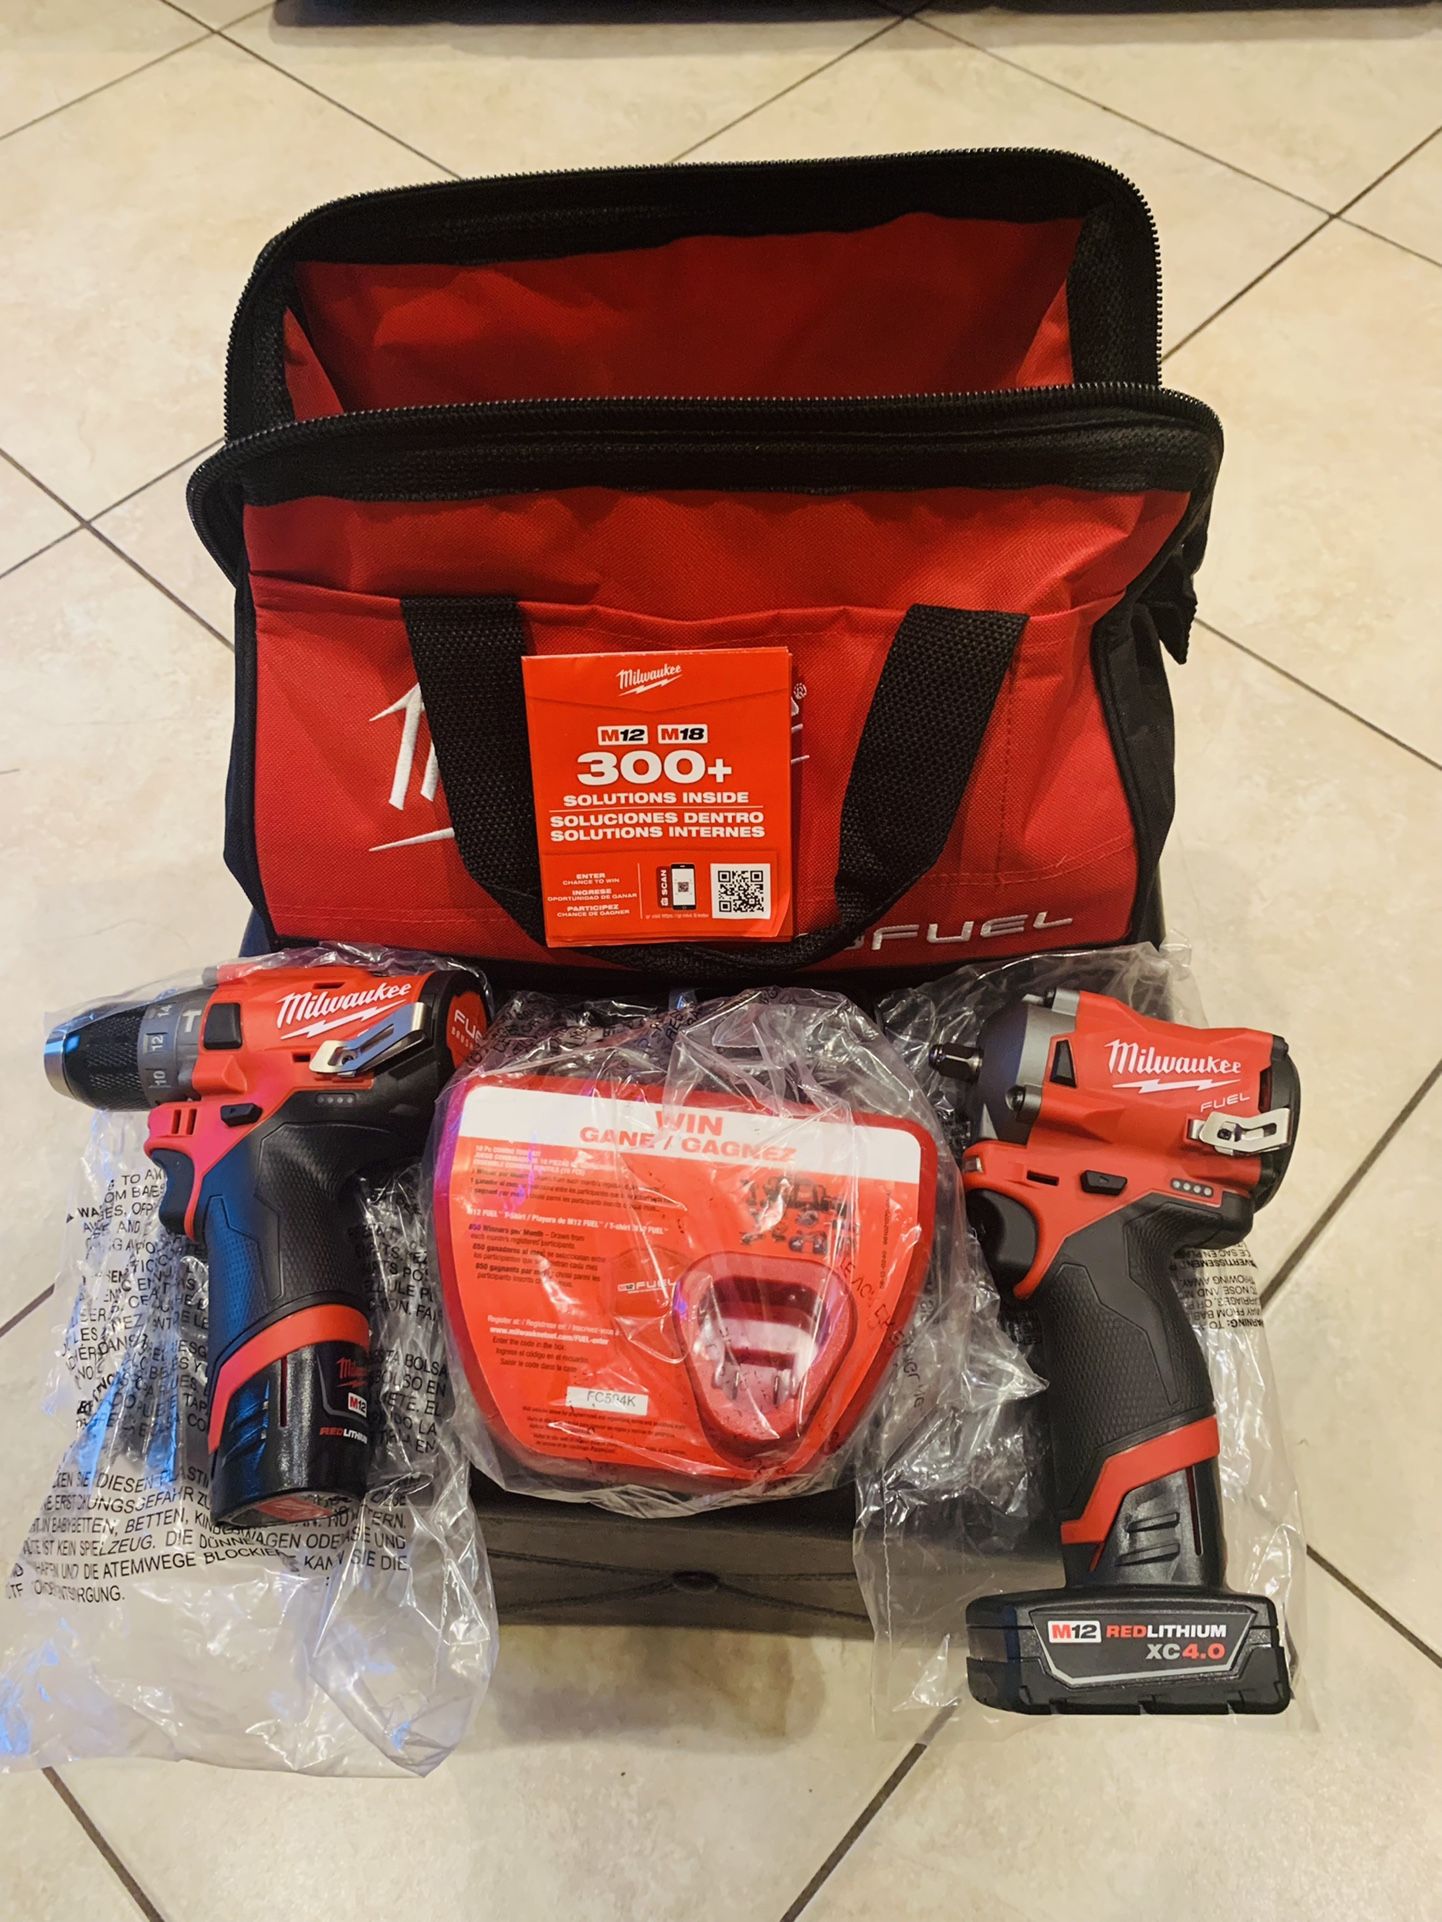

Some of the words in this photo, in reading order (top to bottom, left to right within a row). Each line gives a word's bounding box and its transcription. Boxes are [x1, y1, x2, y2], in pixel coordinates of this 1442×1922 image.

[616, 664, 682, 689] Milwaukee
[601, 729, 645, 741] M12
[661, 728, 704, 740] M18
[577, 750, 732, 786] 300+
[563, 793, 677, 807] SOLUTIONS
[683, 792, 749, 803] INSIDE
[550, 812, 678, 827] SOLUCIONES
[684, 811, 764, 824] DENTRO
[550, 826, 663, 842] SOLUTIONS
[669, 826, 765, 838] INTERNES
[572, 888, 612, 896] INGRESE
[567, 904, 619, 912] PARTICIPEZ
[871, 911, 1073, 951] FUEL
[276, 982, 412, 1028] Milwaukee
[152, 1034, 164, 1051] 12
[1104, 1039, 1241, 1074] Milwaukee
[1200, 1094, 1250, 1112] FUEL
[655, 1110, 723, 1136] WIN
[404, 1353, 448, 1377] BOLSA
[125, 1507, 189, 1534] BETTEN,
[103, 1552, 197, 1579] ATEMWEGE
[381, 1555, 407, 1571] DIE
[1051, 1624, 1098, 1639] M12
[1106, 1624, 1227, 1639] REDLITHIUM
[1145, 1643, 1226, 1660] XC4.0
